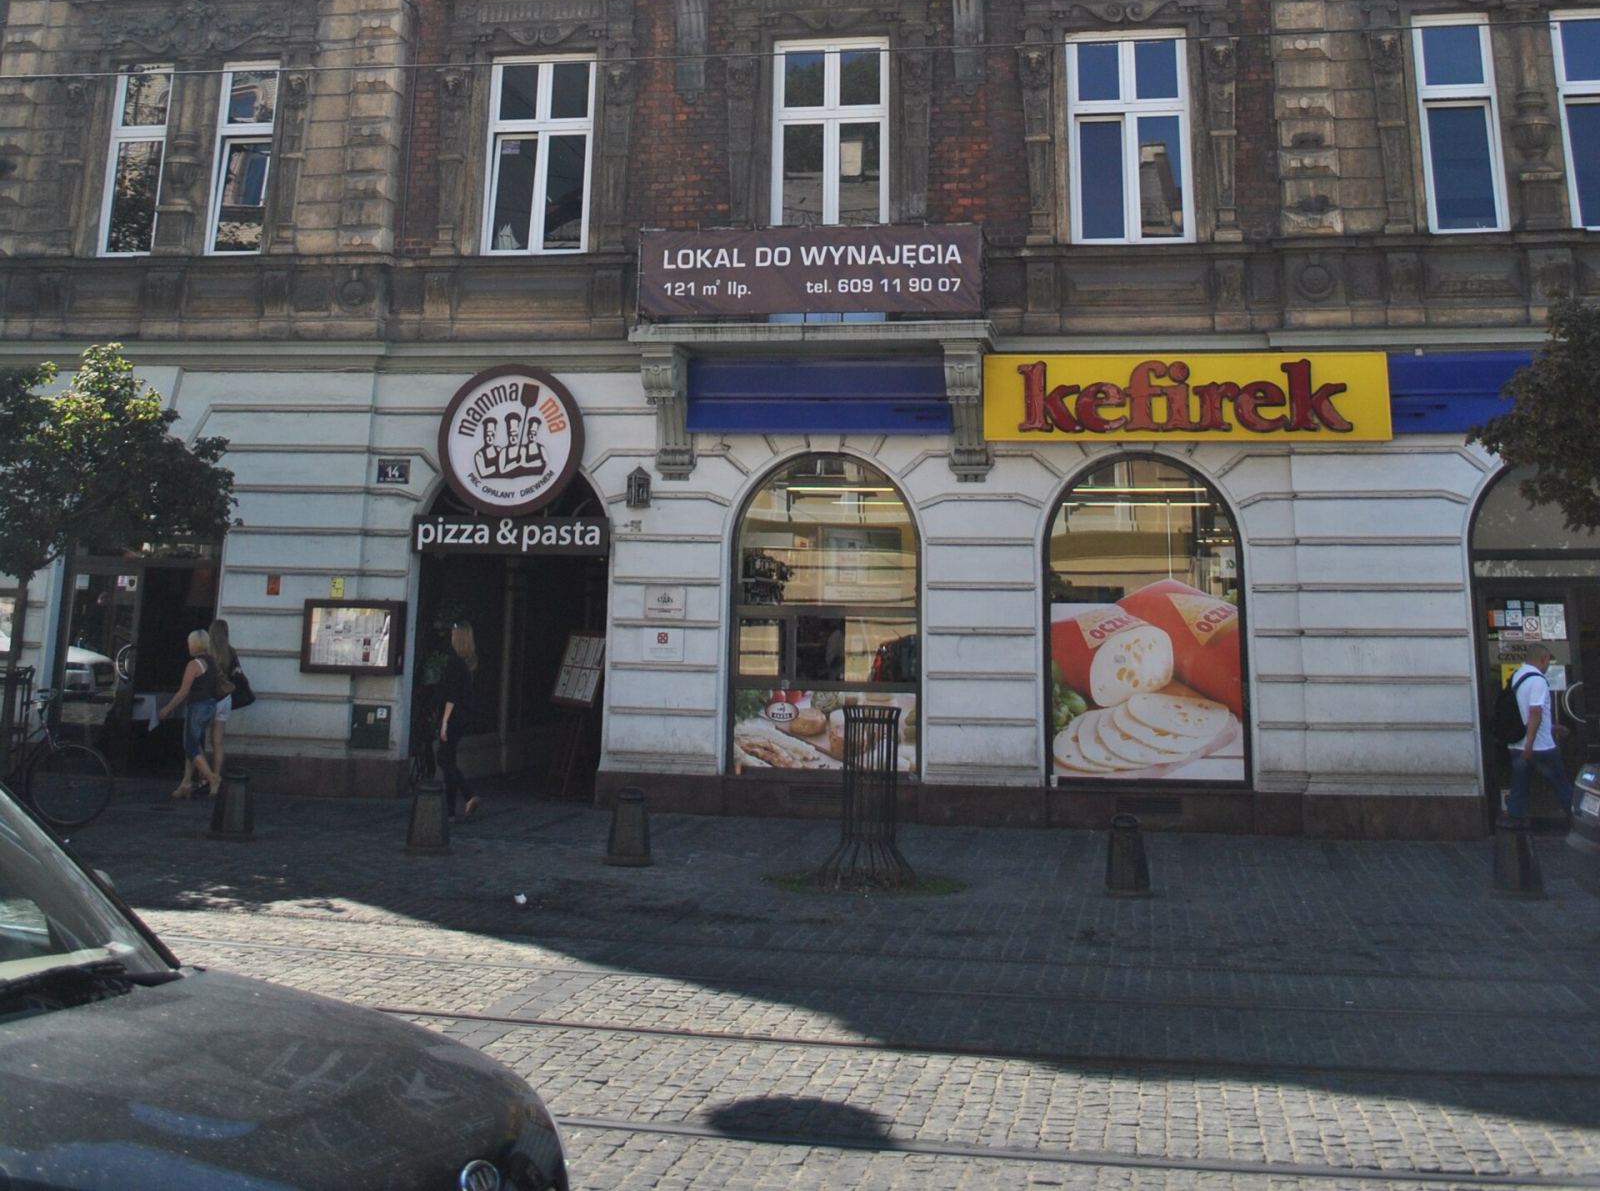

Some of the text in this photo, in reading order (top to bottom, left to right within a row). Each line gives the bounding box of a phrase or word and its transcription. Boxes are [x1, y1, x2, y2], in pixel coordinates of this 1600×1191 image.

[662, 243, 962, 270] LOKAL DO WYNAJĘCIA
[663, 281, 696, 296] 121
[806, 279, 833, 294] tel.
[837, 278, 874, 293] 609
[880, 278, 901, 293] 11
[908, 277, 933, 292] 90
[938, 277, 962, 292] 07
[1016, 358, 1354, 434] kefirek
[458, 382, 567, 438] mamma mia
[386, 465, 400, 478] 14
[467, 472, 482, 488] PIEC
[482, 485, 516, 499] OPALANY
[417, 517, 600, 552] pizza & pasta
